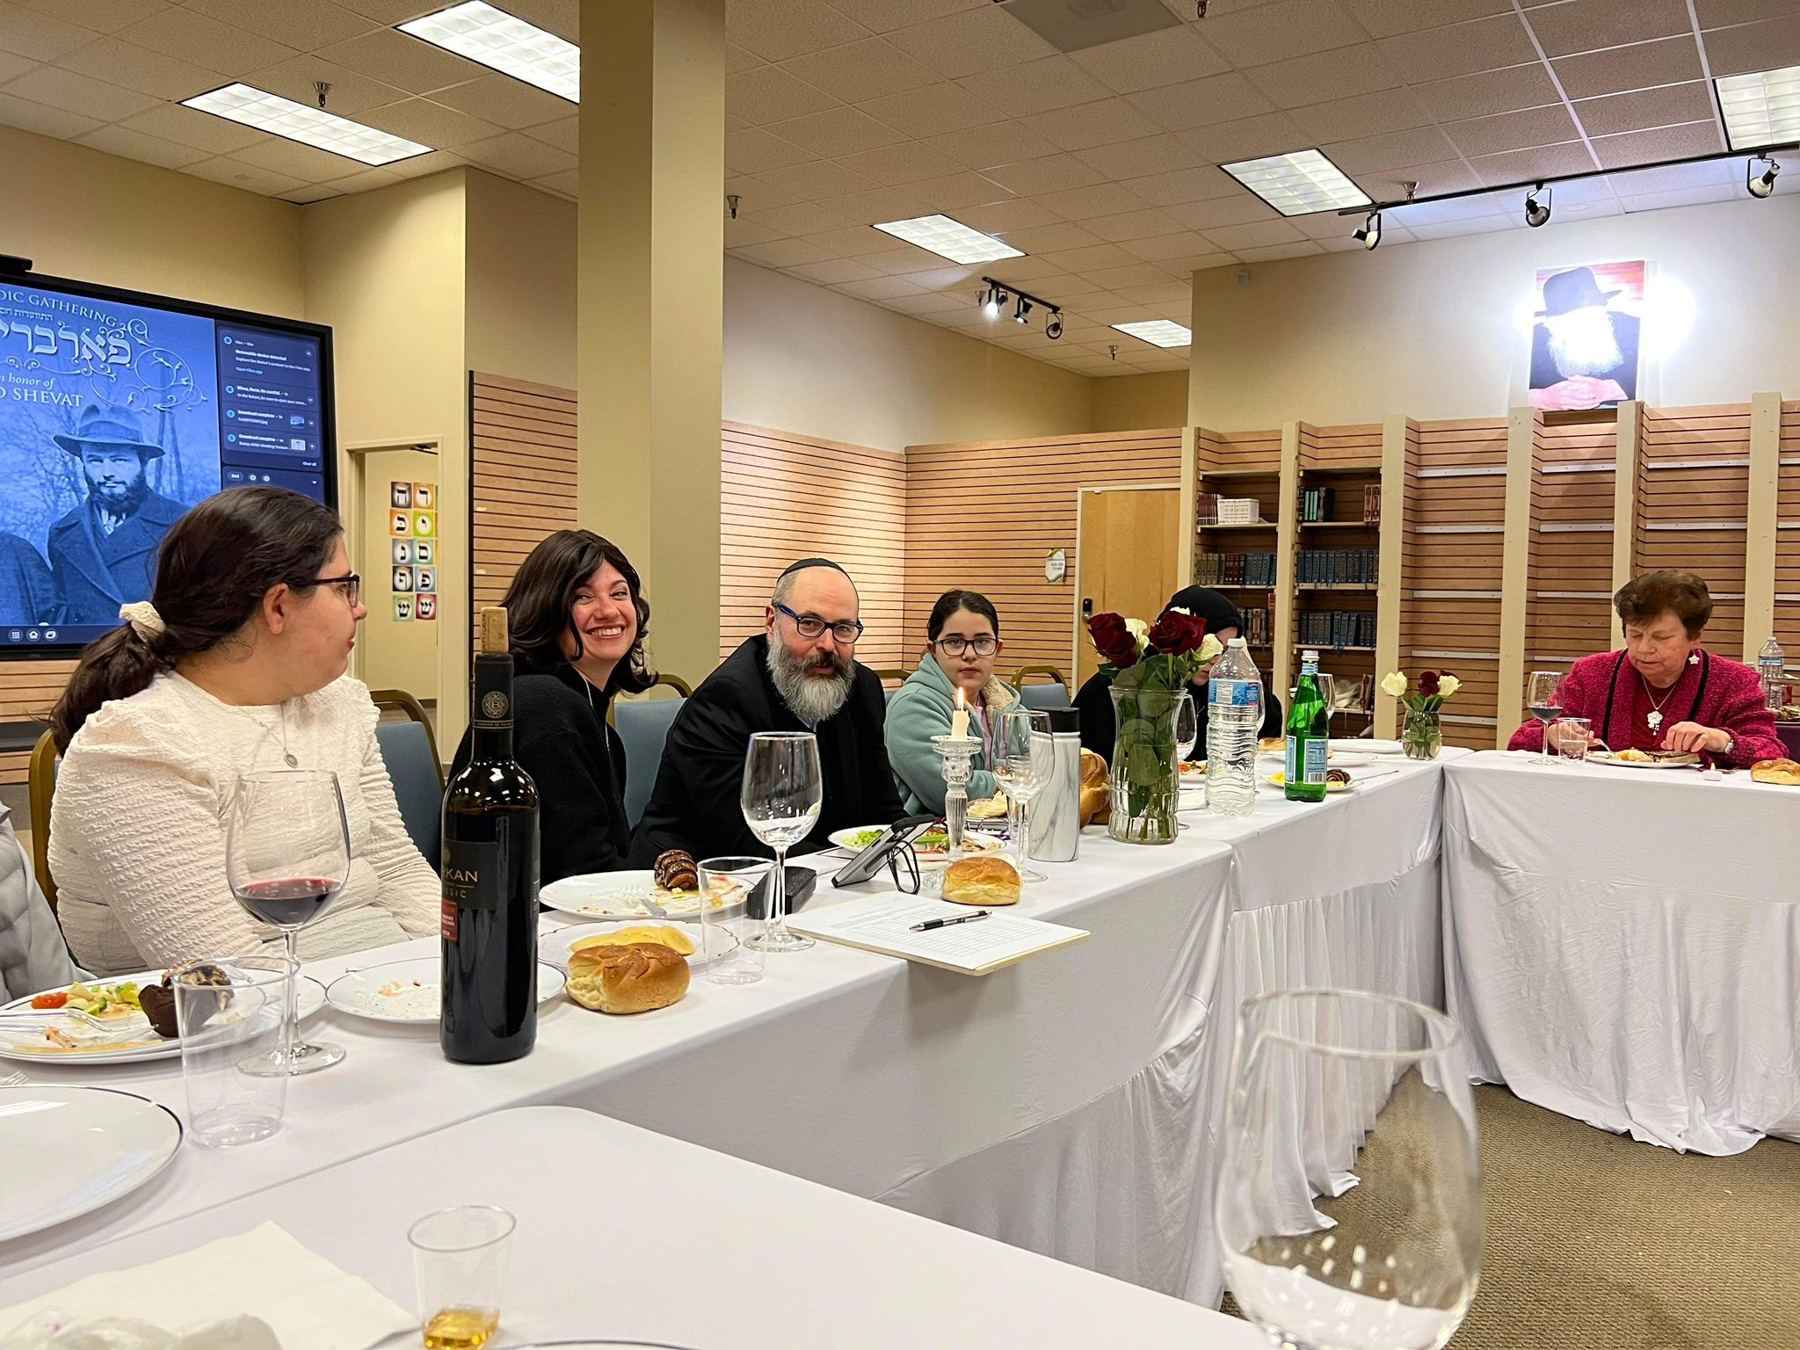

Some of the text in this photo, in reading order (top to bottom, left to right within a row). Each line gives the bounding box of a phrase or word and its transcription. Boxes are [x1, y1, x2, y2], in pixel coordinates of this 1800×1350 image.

[28, 294, 118, 328] GATHERING
[8, 372, 41, 386] honor
[43, 377, 56, 391] of
[13, 387, 84, 407] SHEVAT
[396, 488, 407, 505] ה
[421, 518, 428, 528] י
[400, 545, 406, 560] נ
